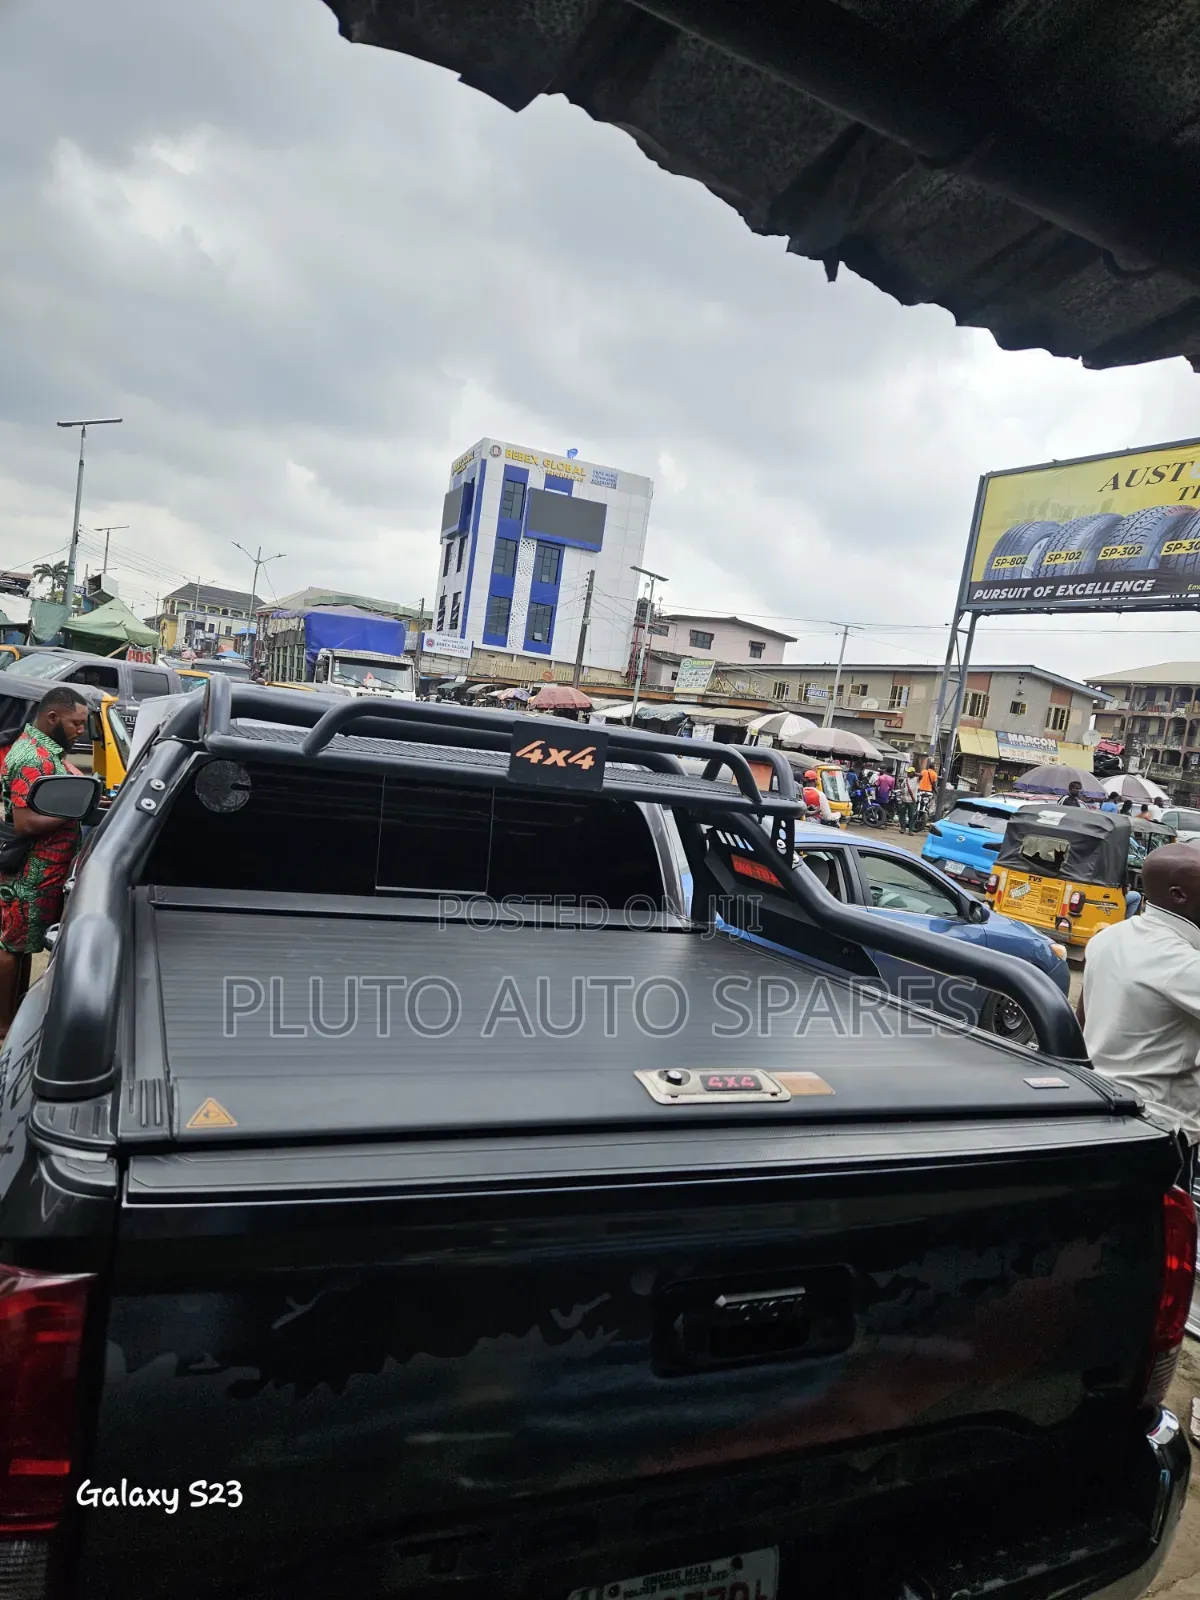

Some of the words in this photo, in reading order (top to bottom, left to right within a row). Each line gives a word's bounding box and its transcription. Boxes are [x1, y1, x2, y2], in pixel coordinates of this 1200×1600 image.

[505, 449, 539, 465] BEBEX
[543, 458, 587, 477] GLOBAL
[1046, 551, 1083, 563] SP-102
[1101, 546, 1143, 558] SP-302
[994, 556, 1028, 567] SP-802
[973, 587, 1031, 600] PURSUIT
[1033, 586, 1055, 598] OF
[1056, 578, 1157, 597] EXCELLENCE
[1007, 733, 1056, 747] MARCON
[516, 740, 597, 770] 4x4
[1028, 875, 1043, 883] TVS
